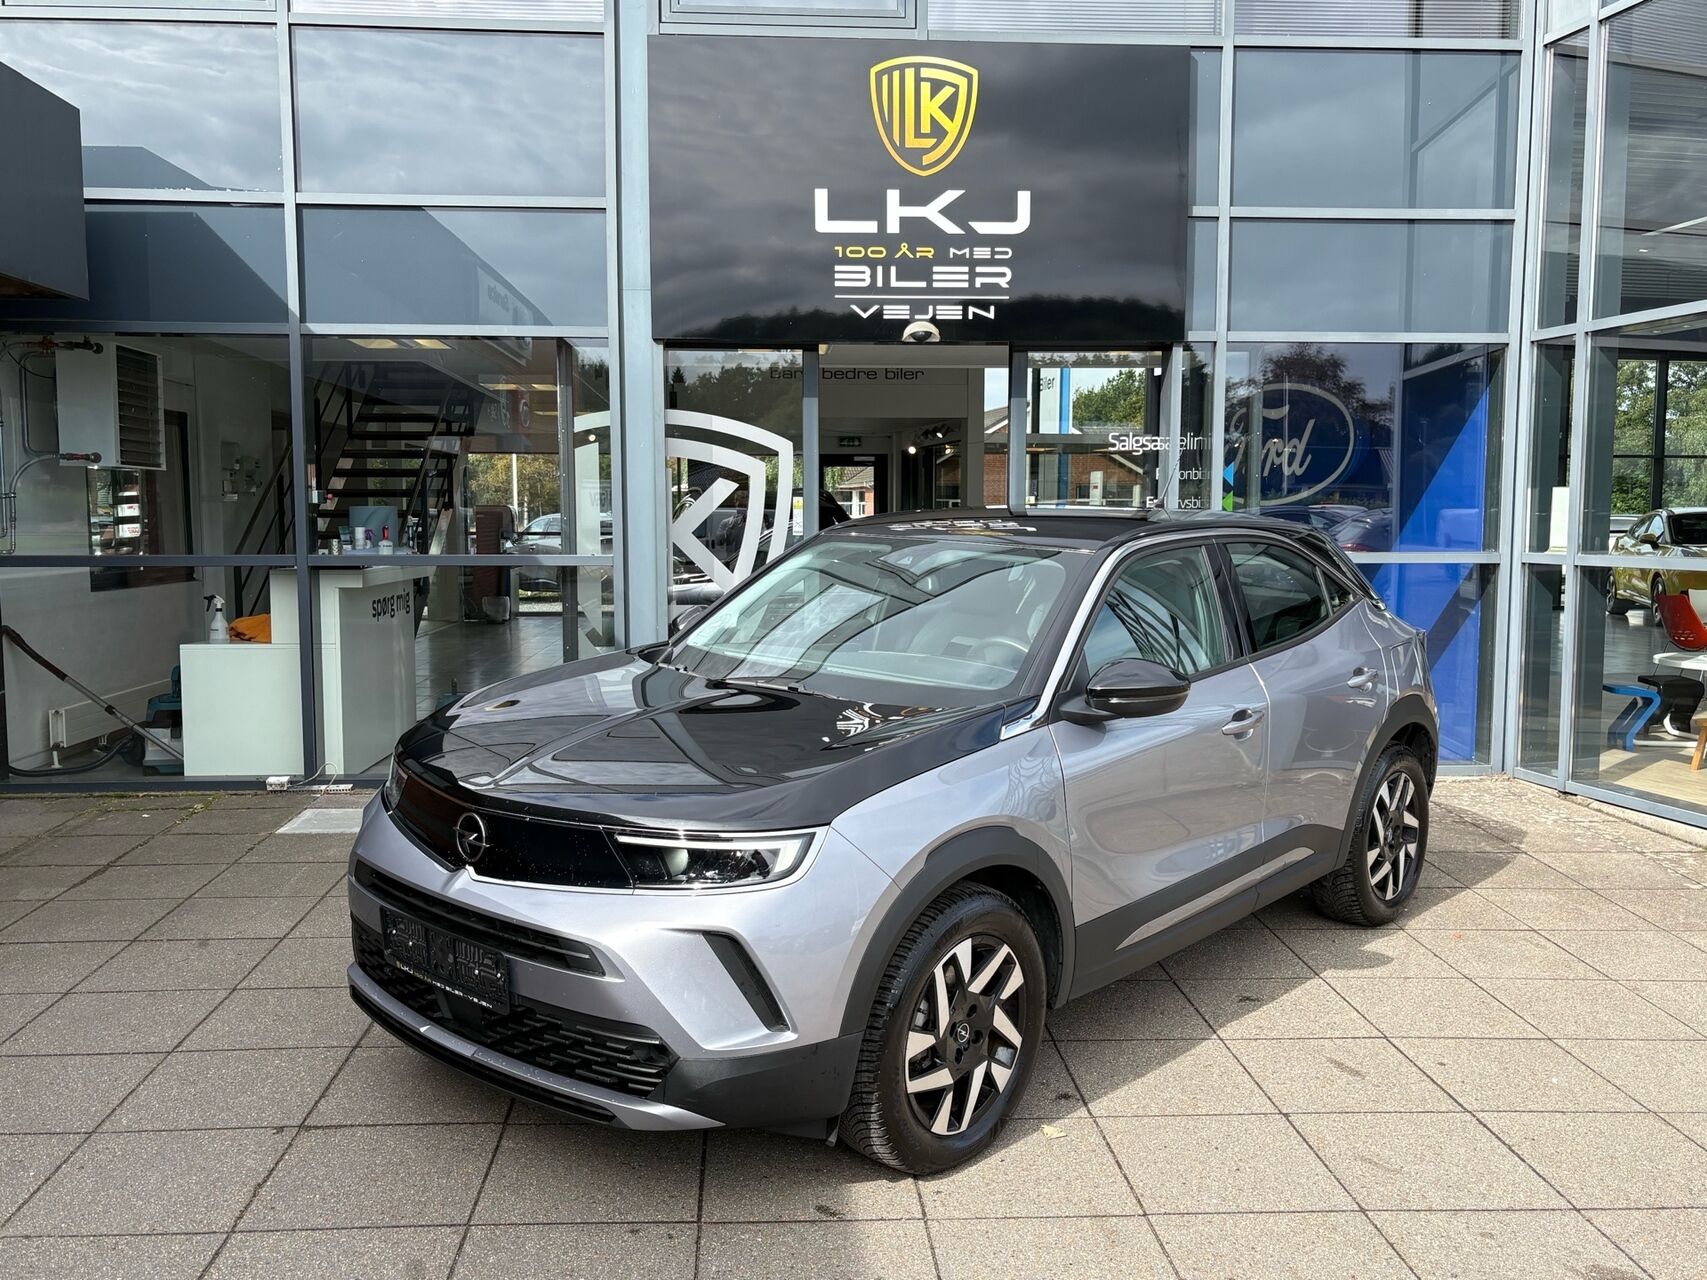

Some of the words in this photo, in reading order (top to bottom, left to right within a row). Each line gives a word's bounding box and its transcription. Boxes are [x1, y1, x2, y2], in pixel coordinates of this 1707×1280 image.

[814, 188, 1031, 235] LKJ
[834, 246, 887, 258] 100
[894, 242, 935, 259] ÅR
[949, 247, 1013, 259] MED
[834, 265, 1013, 288] BILER
[850, 304, 995, 320] VEJEN
[822, 367, 878, 380] bedre
[884, 367, 925, 380] biler
[372, 594, 395, 622] spørg
[396, 588, 410, 614] mig
[468, 995, 493, 1009] VEJEN
